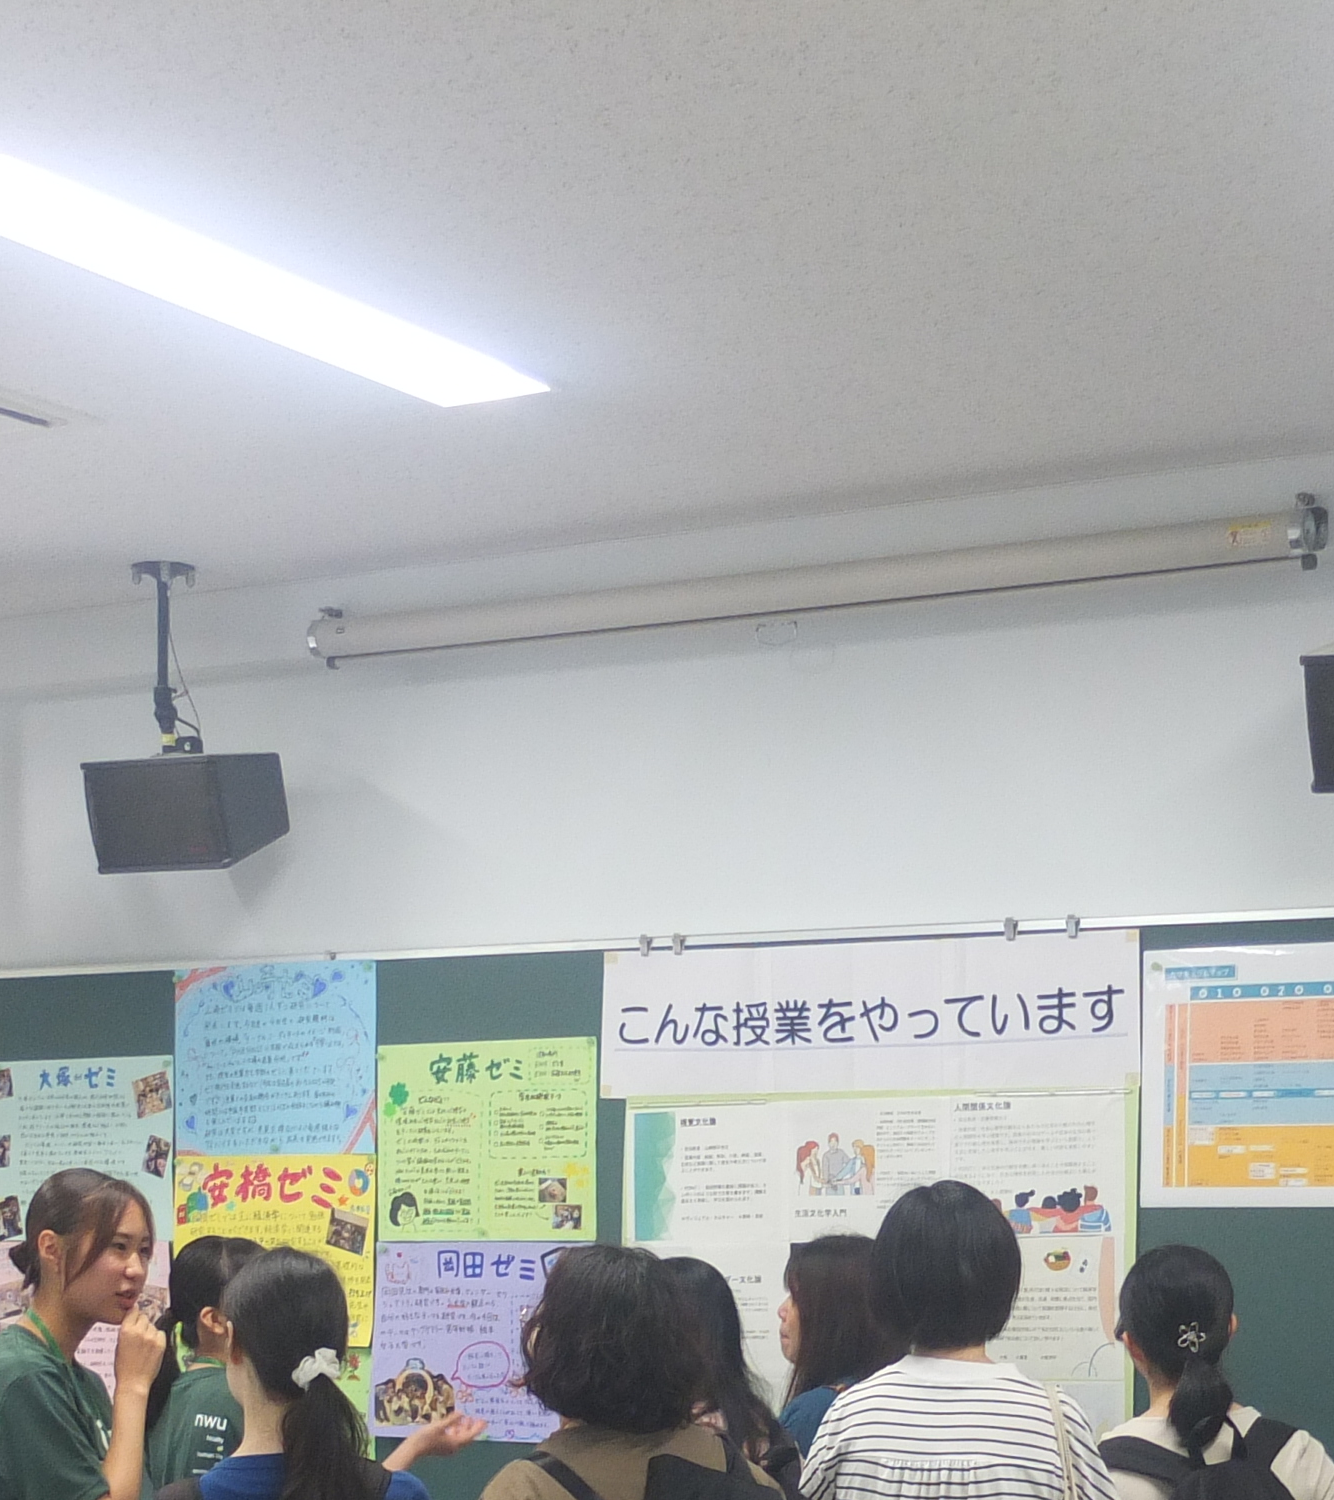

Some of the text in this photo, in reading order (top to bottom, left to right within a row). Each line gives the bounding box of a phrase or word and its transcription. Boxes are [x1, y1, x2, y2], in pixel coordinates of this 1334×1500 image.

[617, 984, 1125, 1046] こんな授業をやっています
[429, 1052, 524, 1085] 安藤ゼミ
[202, 1162, 343, 1209] 安橋ゼミ
[437, 1250, 536, 1281] 岡田ゼミ
[194, 1413, 228, 1431] nwu
